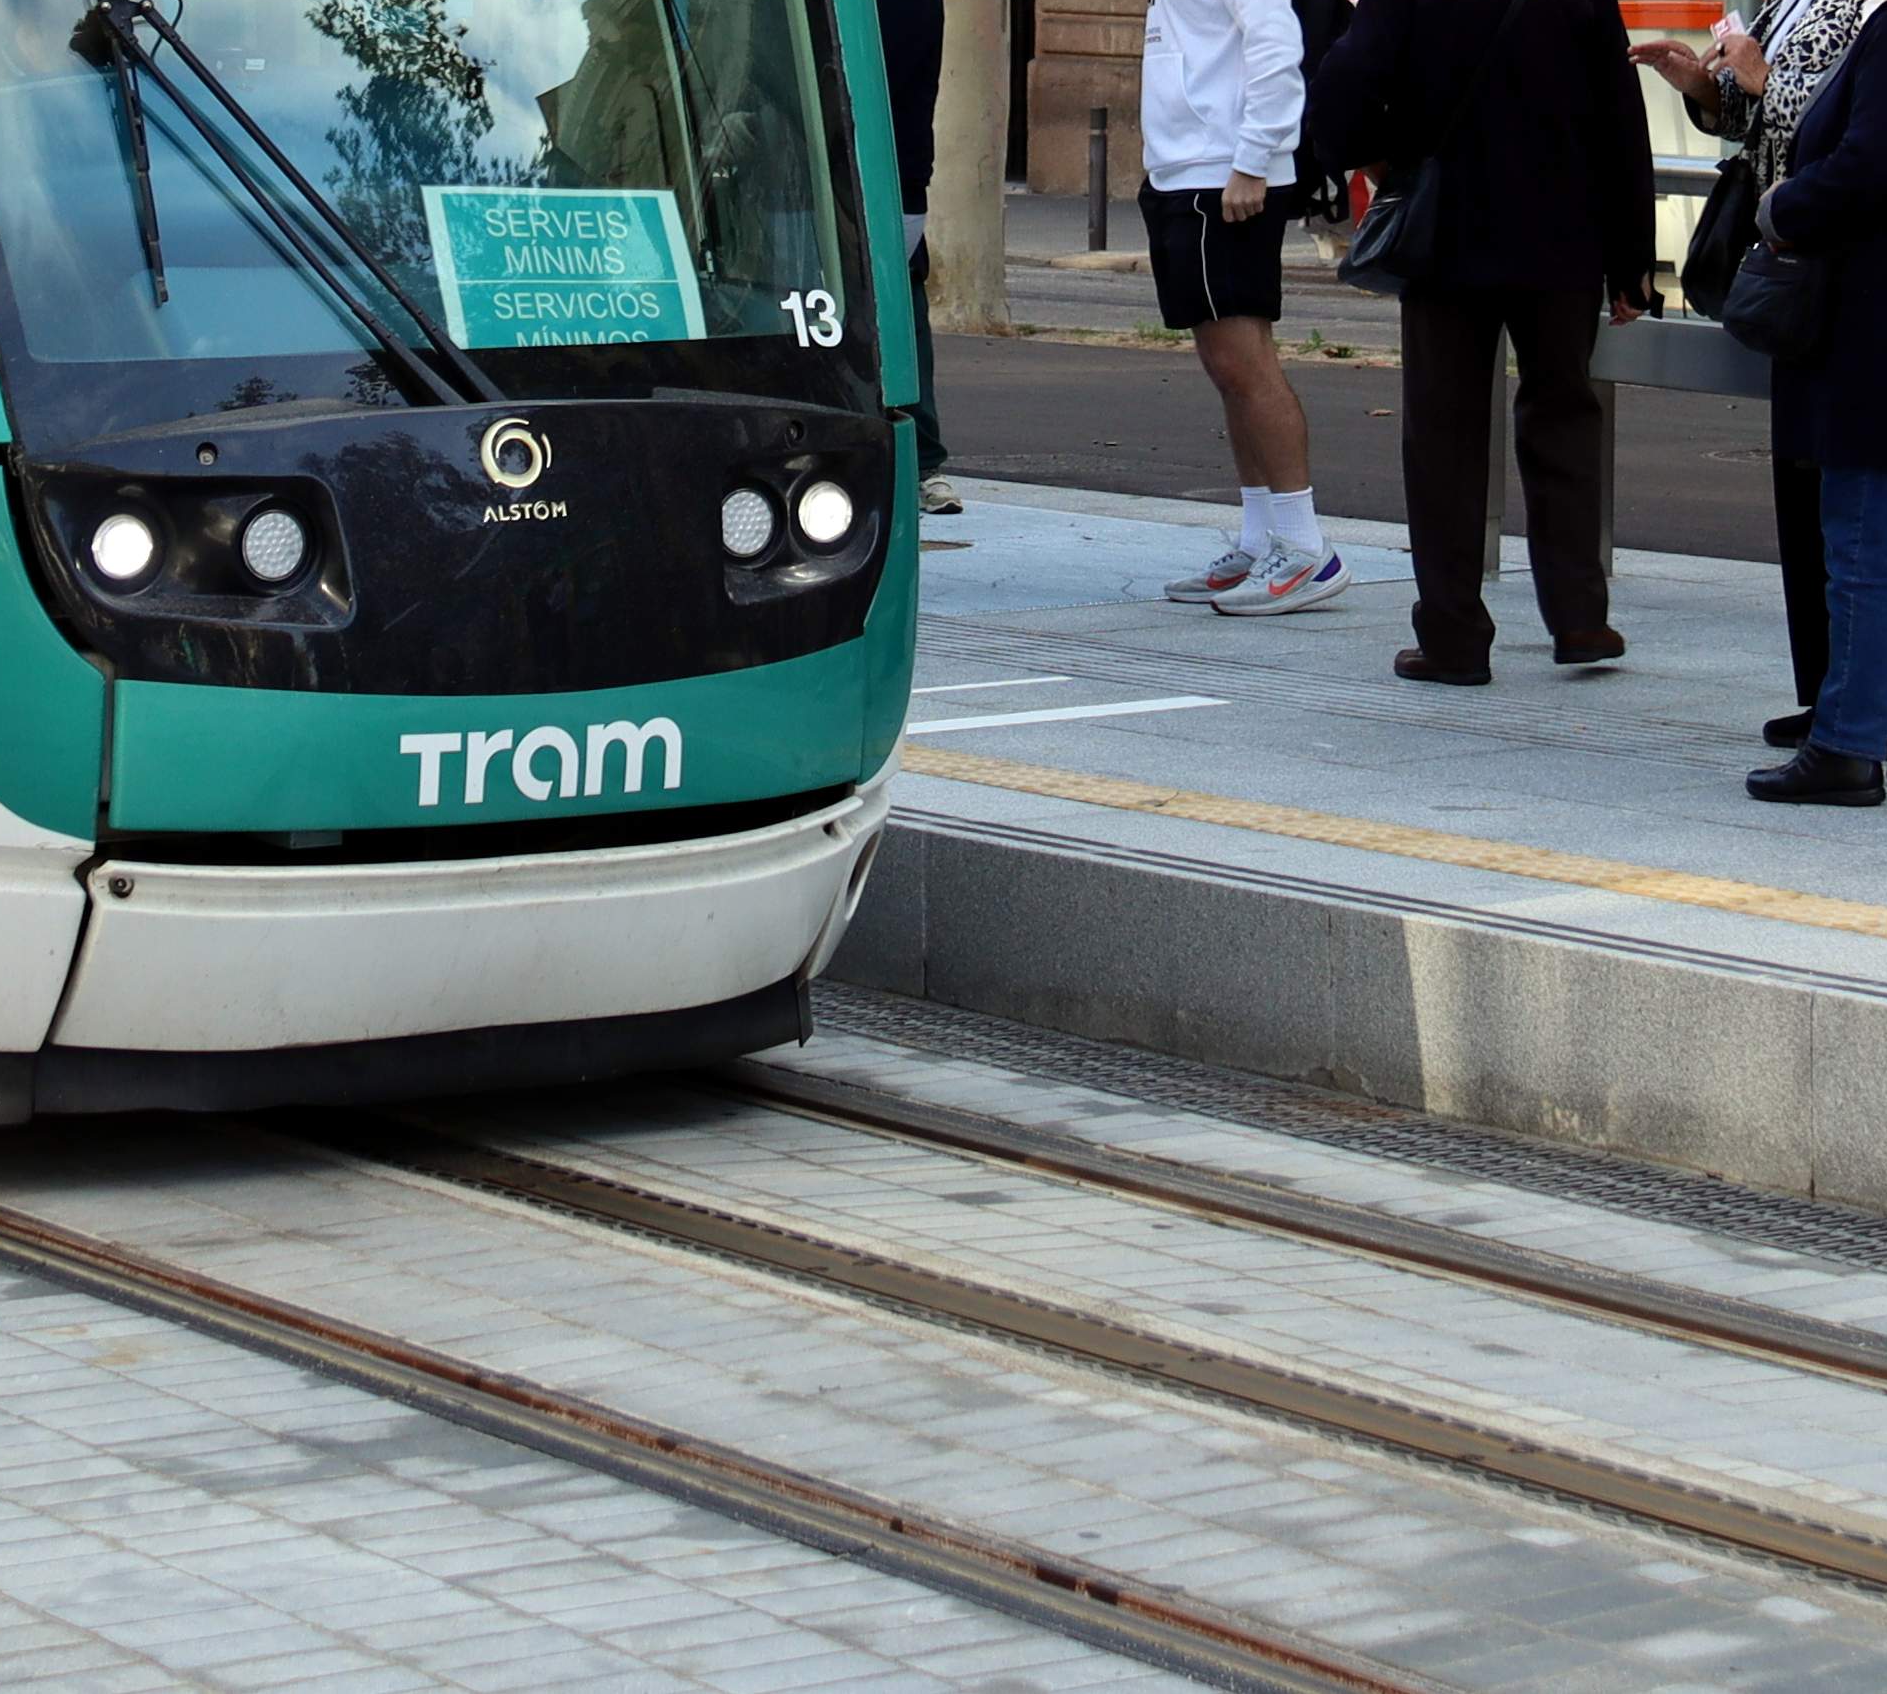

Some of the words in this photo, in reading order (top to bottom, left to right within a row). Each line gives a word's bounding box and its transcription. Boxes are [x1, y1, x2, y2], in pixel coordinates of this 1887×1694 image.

[484, 208, 628, 240] SERVEIS
[503, 239, 626, 275] MÍNIMS
[493, 290, 661, 319] SERVICIOS
[780, 289, 843, 347] 13
[483, 500, 568, 523] ALSTOM
